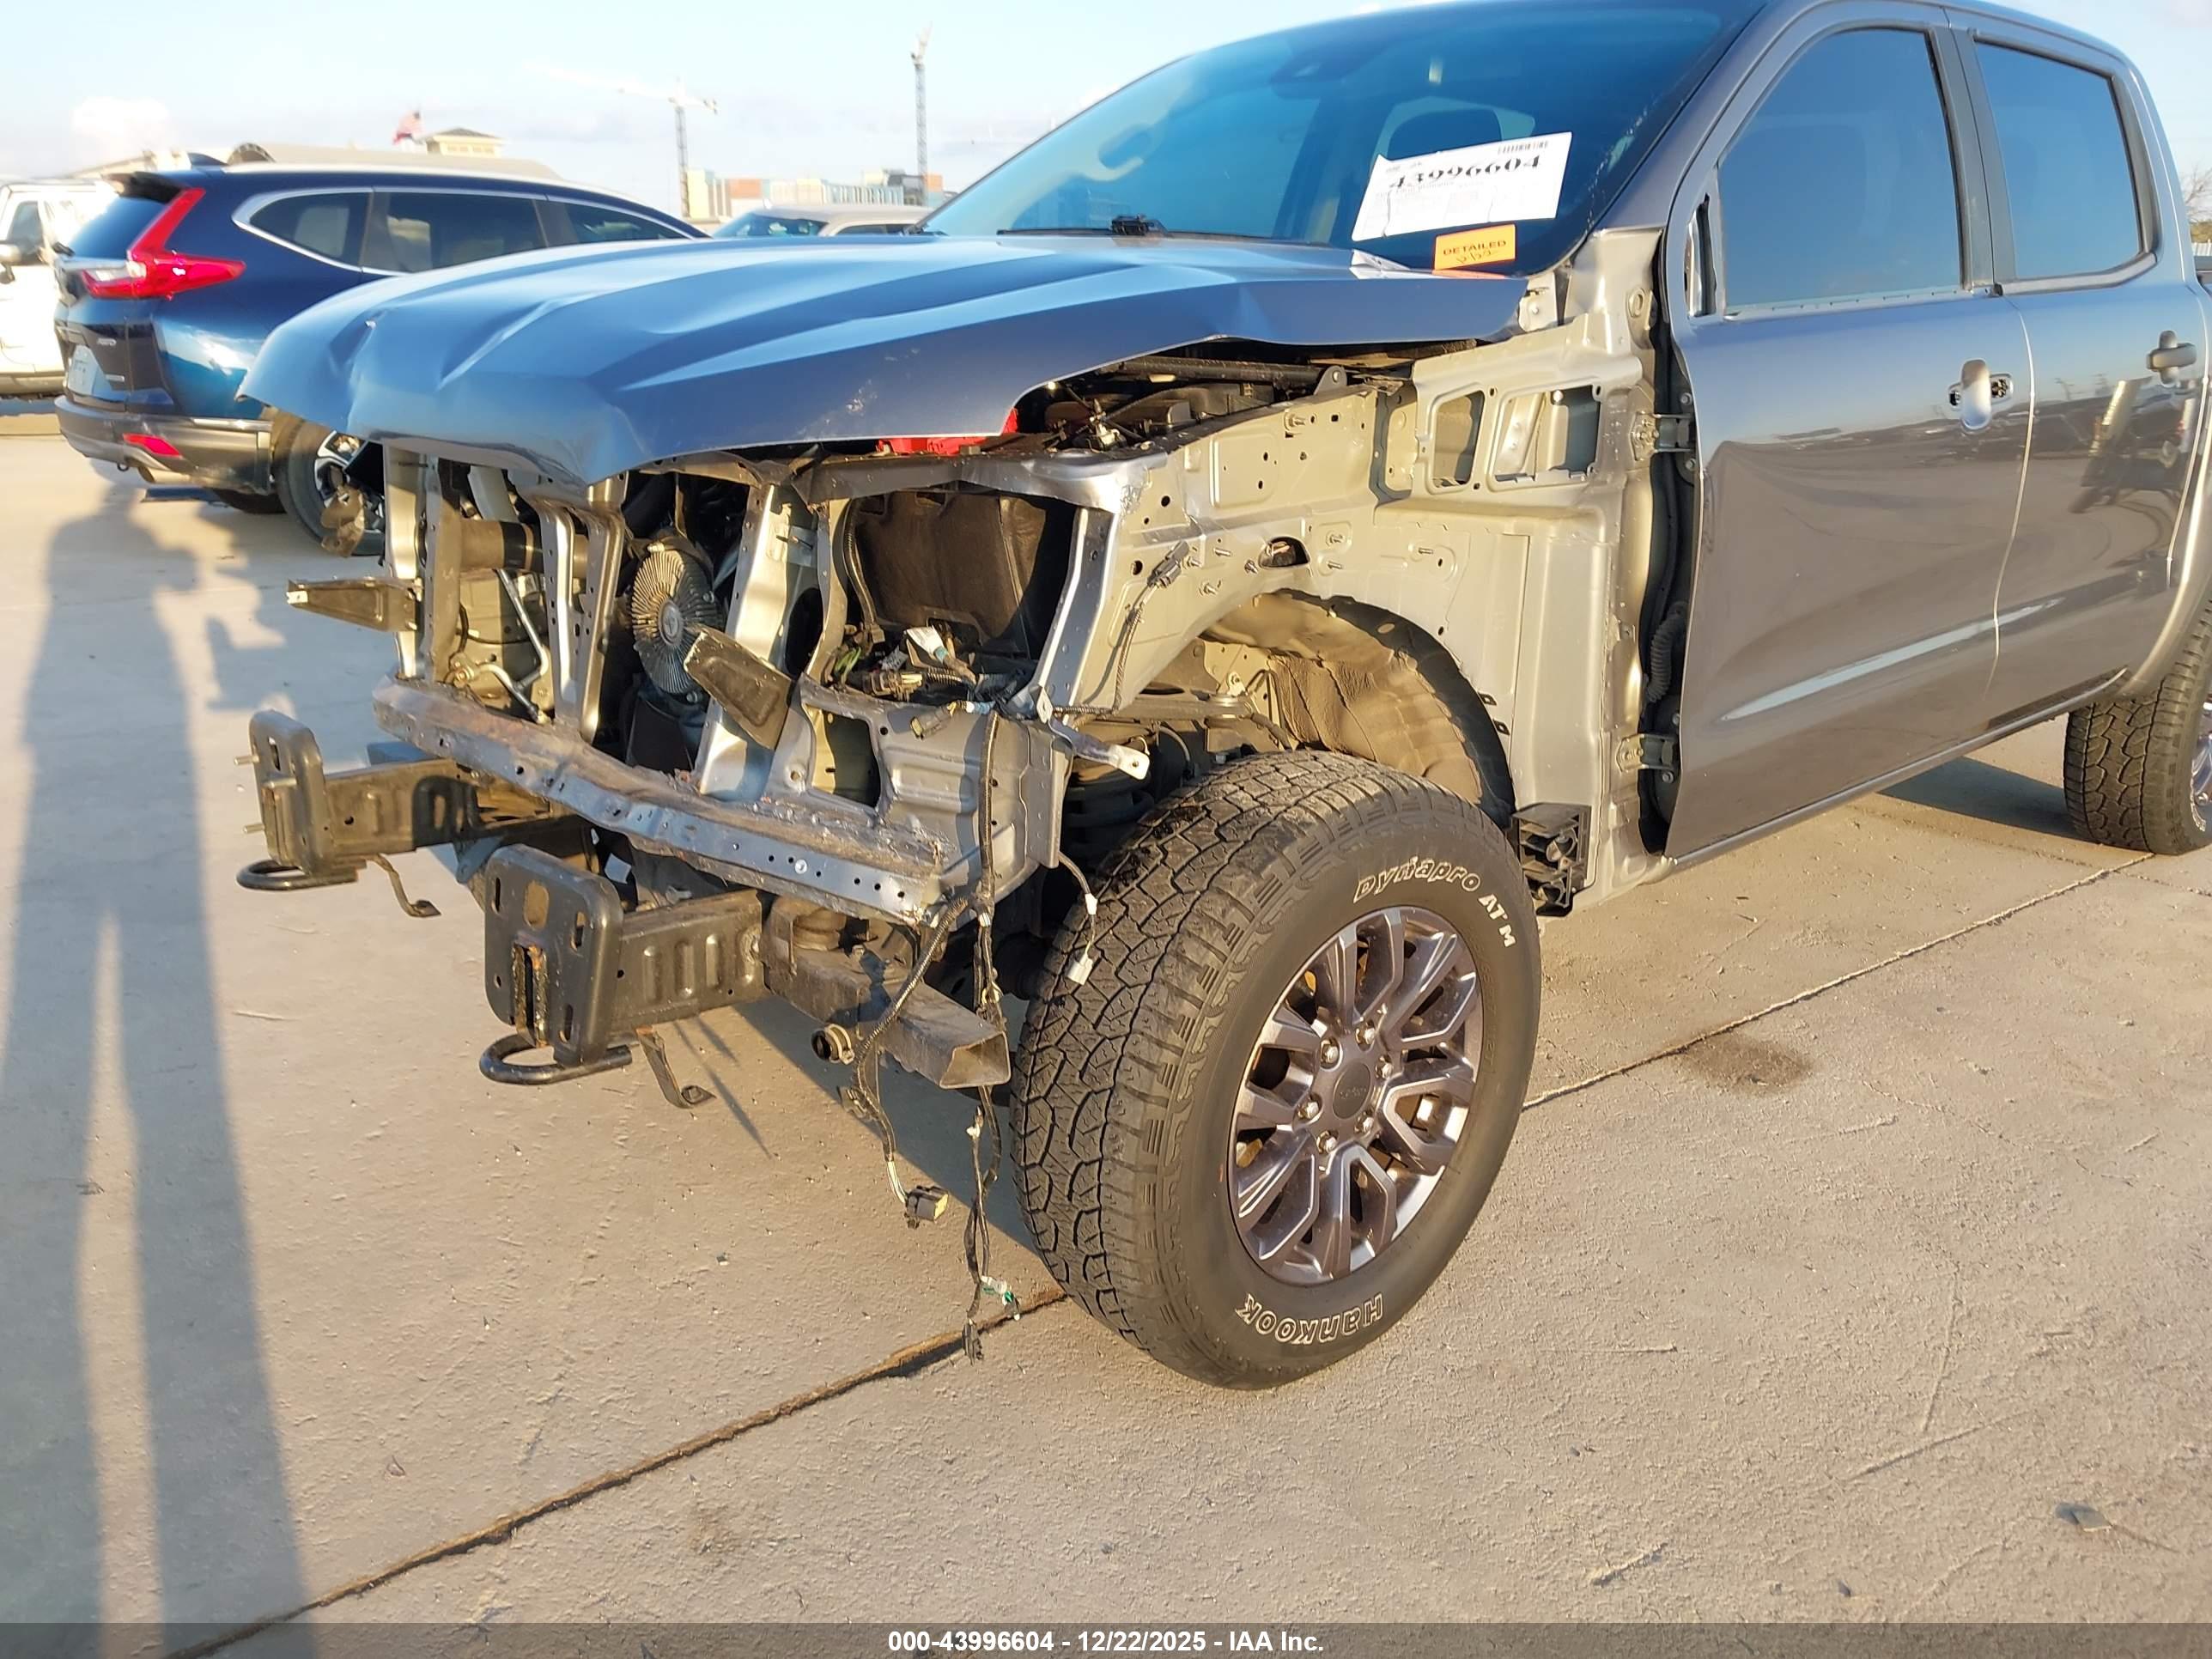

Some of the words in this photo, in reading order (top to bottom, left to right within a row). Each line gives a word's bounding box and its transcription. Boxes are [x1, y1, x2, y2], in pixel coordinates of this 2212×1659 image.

[1389, 155, 1540, 189] 43996604
[1443, 240, 1507, 256] DETAILED
[1352, 855, 1481, 903] Dynapro
[1235, 1292, 1383, 1345] Hankook
